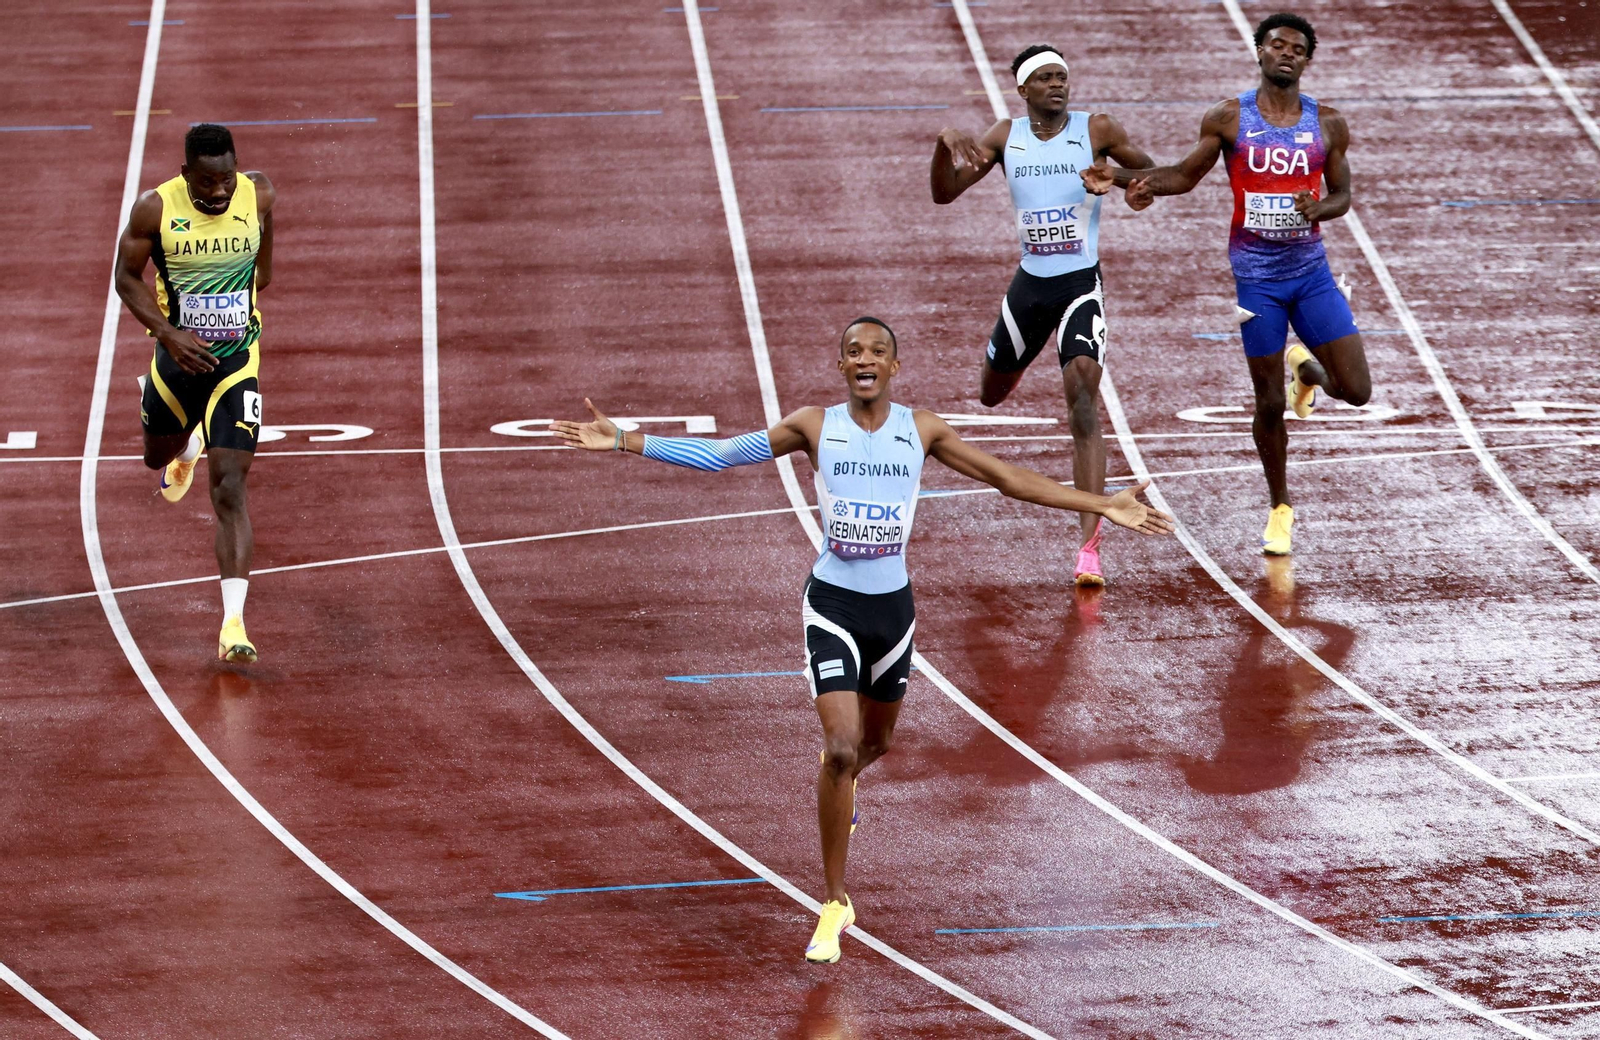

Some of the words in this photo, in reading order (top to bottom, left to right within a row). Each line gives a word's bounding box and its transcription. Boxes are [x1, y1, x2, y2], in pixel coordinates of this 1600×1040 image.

[1248, 146, 1309, 175] USA
[1014, 163, 1077, 178] BOTSWANA
[1264, 196, 1295, 209] TD
[1032, 206, 1078, 224] TDK
[1027, 224, 1076, 242] EPPIE
[173, 237, 252, 255] JAMAICA
[199, 293, 244, 309] TDK
[183, 311, 247, 327] McDONALD
[251, 398, 259, 419] 6
[833, 461, 910, 478] BOTSWANA
[848, 501, 902, 521] TDK
[829, 519, 904, 542] KEBINATSHIPI
